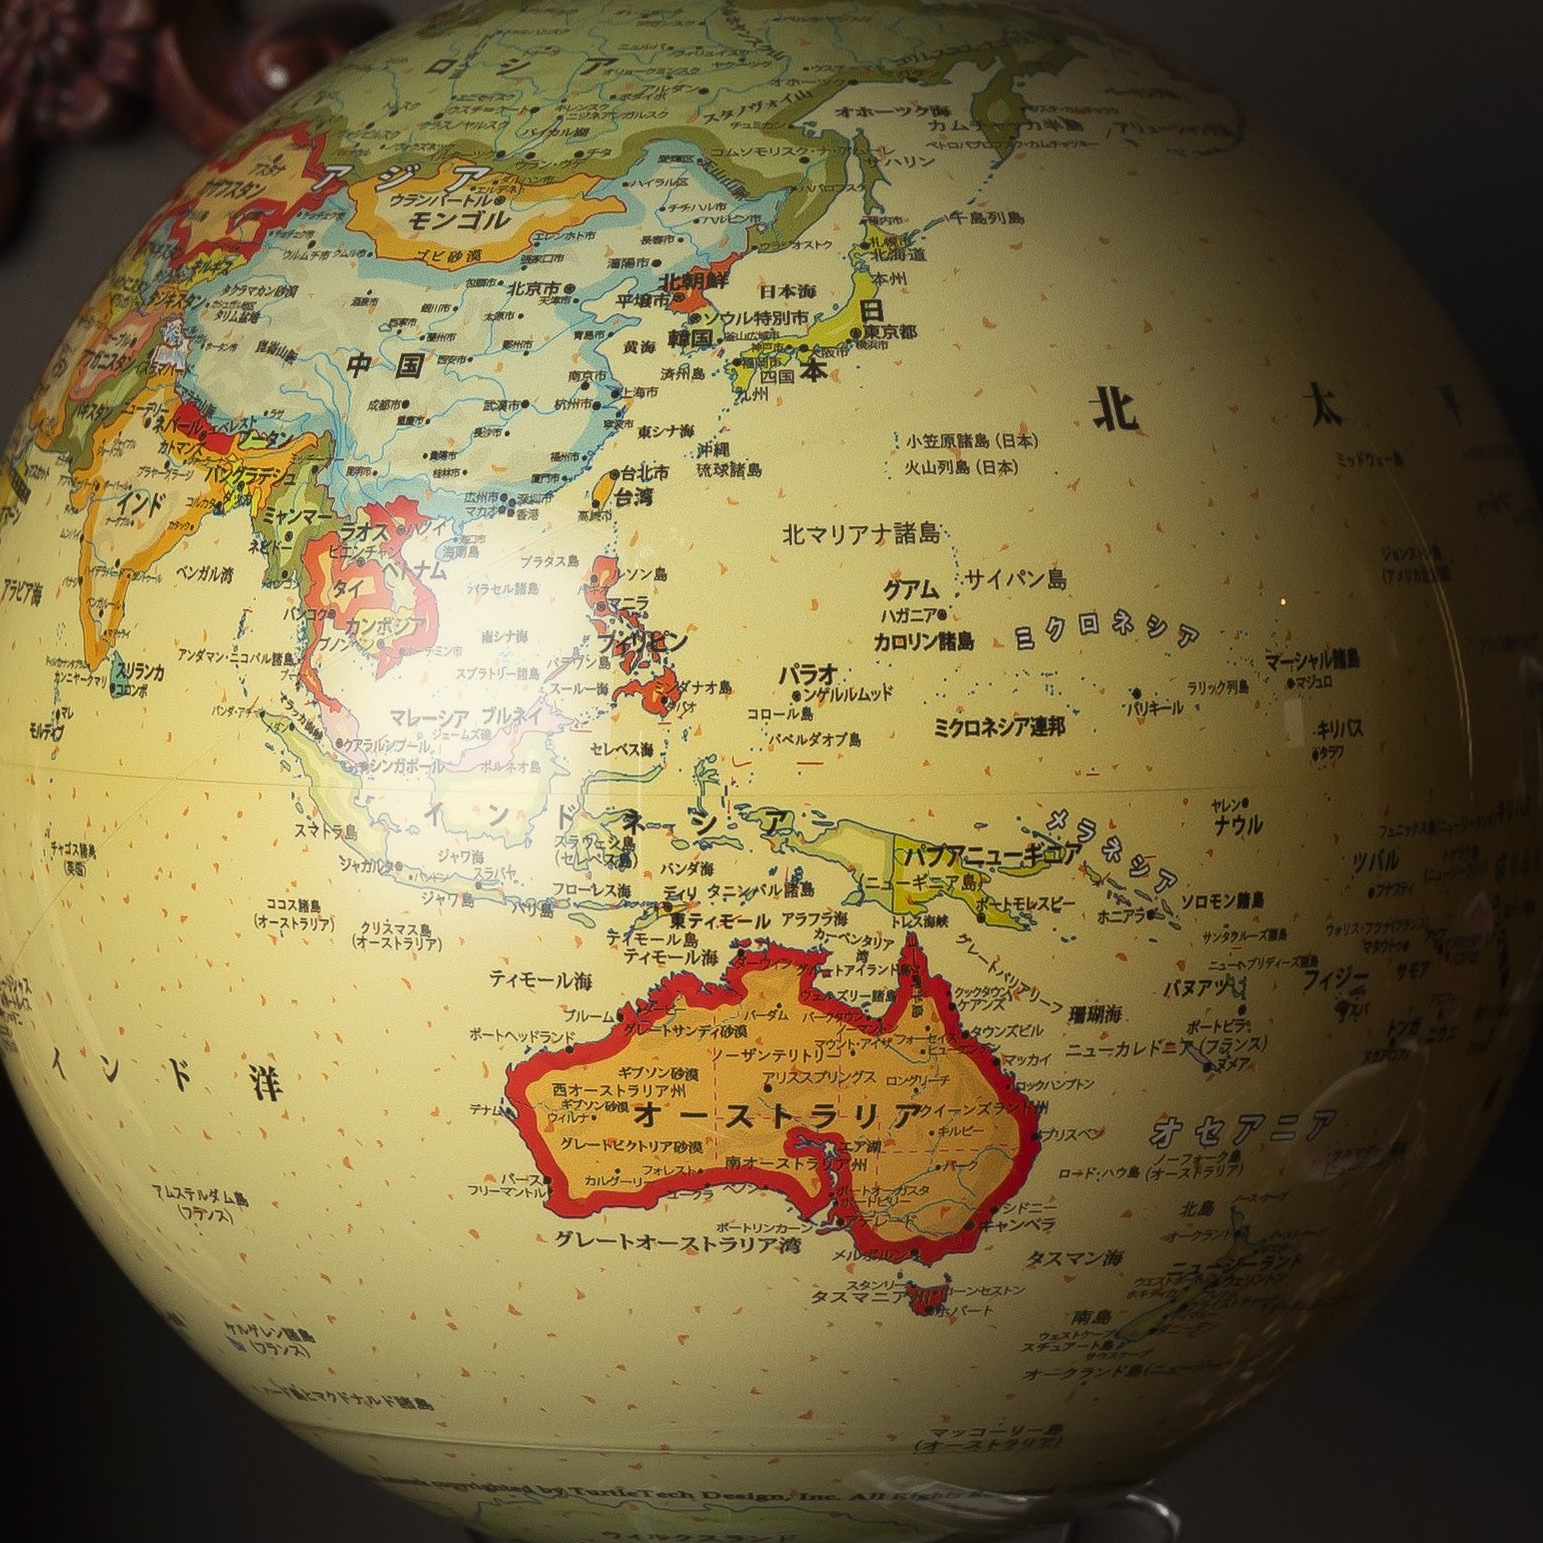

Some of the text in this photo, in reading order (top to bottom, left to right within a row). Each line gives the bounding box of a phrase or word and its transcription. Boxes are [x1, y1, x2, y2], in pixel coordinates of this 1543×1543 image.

[409, 211, 511, 231] モンゴル
[508, 281, 562, 296] 北京市
[760, 284, 817, 299] 日本海
[668, 329, 713, 348] 韓国
[863, 324, 917, 340] 東京都
[347, 352, 425, 378] 中国
[760, 370, 795, 385] 四国
[638, 424, 695, 439] 東シナ海
[620, 465, 670, 482] 台北市
[904, 459, 971, 475] 火山列島
[614, 488, 654, 507] 台湾
[340, 524, 389, 541] ラオス
[782, 520, 940, 546] 北マリアナ諸島
[964, 569, 1067, 591] サイパン島
[334, 580, 364, 598] タイ
[882, 579, 940, 601] グアム
[874, 631, 975, 651] カロリン諸島
[778, 663, 839, 685] パラオ
[391, 709, 470, 727] マレーシア
[748, 707, 814, 722] コロール島
[934, 716, 1067, 738] ミクロネシア連邦
[590, 743, 654, 757] セレベス海
[294, 824, 358, 841] スマトラ島
[660, 862, 714, 876] バンダ海
[267, 899, 321, 913] ココス諸島
[254, 914, 335, 932] (オーストラリア)
[670, 914, 771, 930] 東ティモール
[782, 912, 848, 927] アラフラ海
[352, 936, 442, 952] (オーストラリア)
[606, 932, 698, 948] ティモール島
[624, 950, 719, 966] ティモール海
[490, 971, 593, 991] ティモール海
[618, 1067, 699, 1082] ギブソン砂漠
[762, 1071, 877, 1084] アリススプリングス
[552, 1083, 686, 1098] 西オーストラリア州
[634, 1101, 923, 1130] オーストラリア
[1148, 1110, 1337, 1149] オセアニア
[1026, 1250, 1126, 1267] タスマン海
[567, 1487, 694, 1500] TurtleTech
